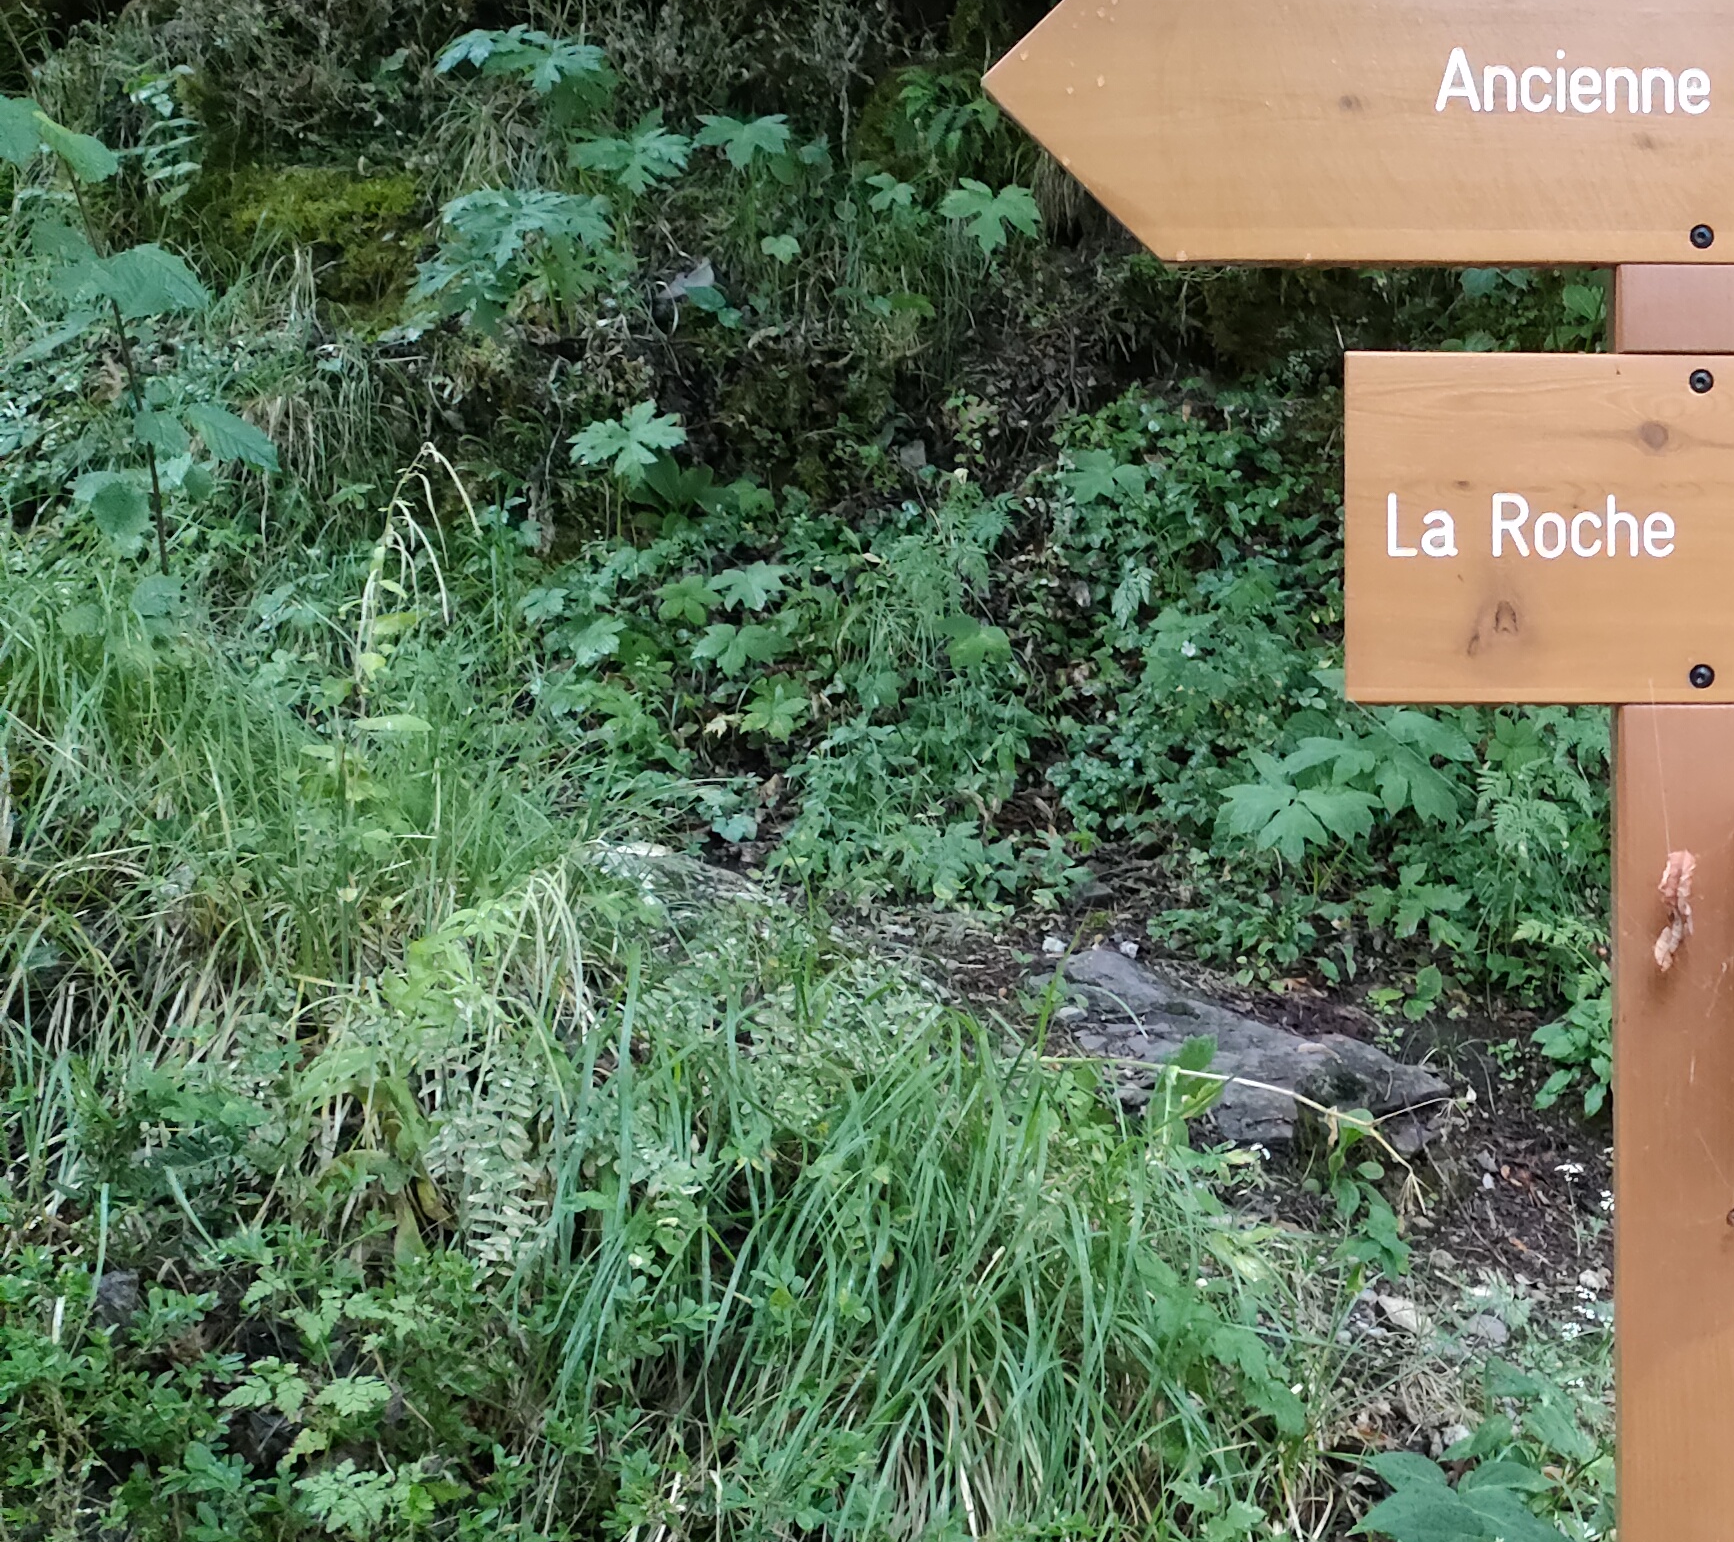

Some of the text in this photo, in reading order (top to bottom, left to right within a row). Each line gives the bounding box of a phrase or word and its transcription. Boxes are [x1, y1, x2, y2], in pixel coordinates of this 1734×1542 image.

[1435, 47, 1711, 115] Ancienne
[1386, 491, 1676, 559] La Roche
